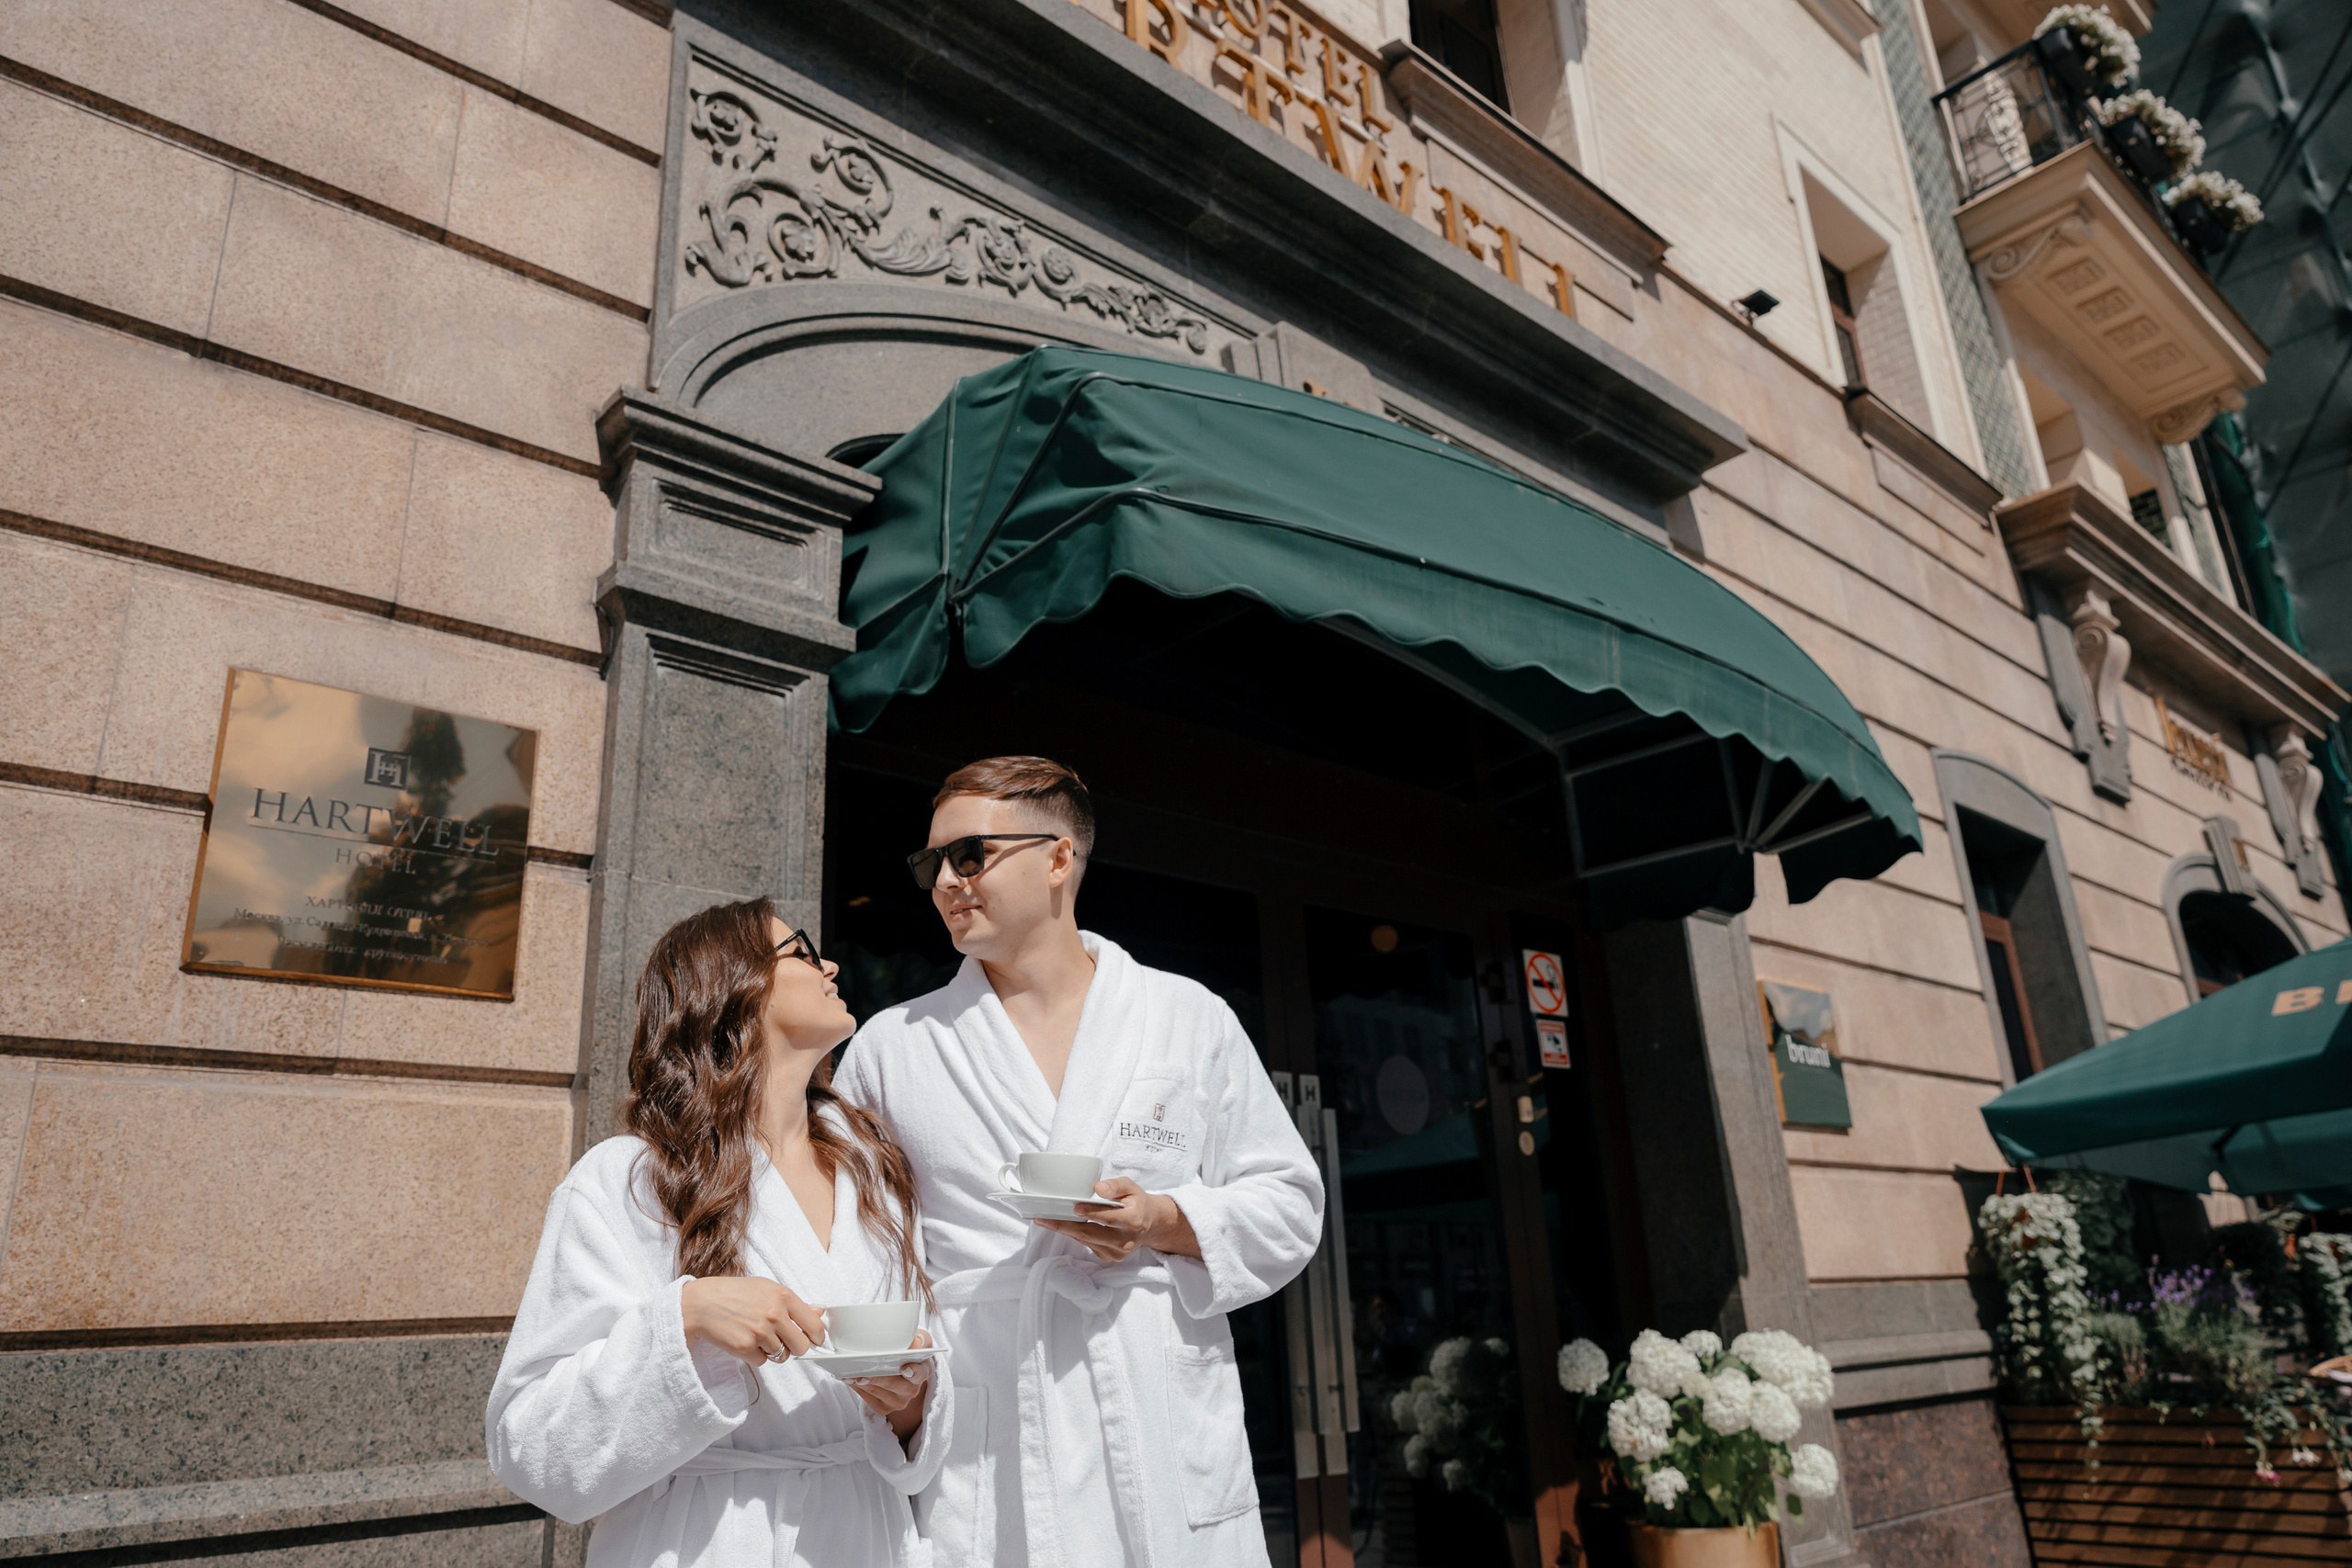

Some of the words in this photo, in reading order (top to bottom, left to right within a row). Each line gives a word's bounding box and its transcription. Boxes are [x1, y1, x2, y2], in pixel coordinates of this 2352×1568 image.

[1197, 0, 1393, 133] OTEL
[250, 786, 500, 856] HARTWELL
[335, 847, 415, 874] HOTEL
